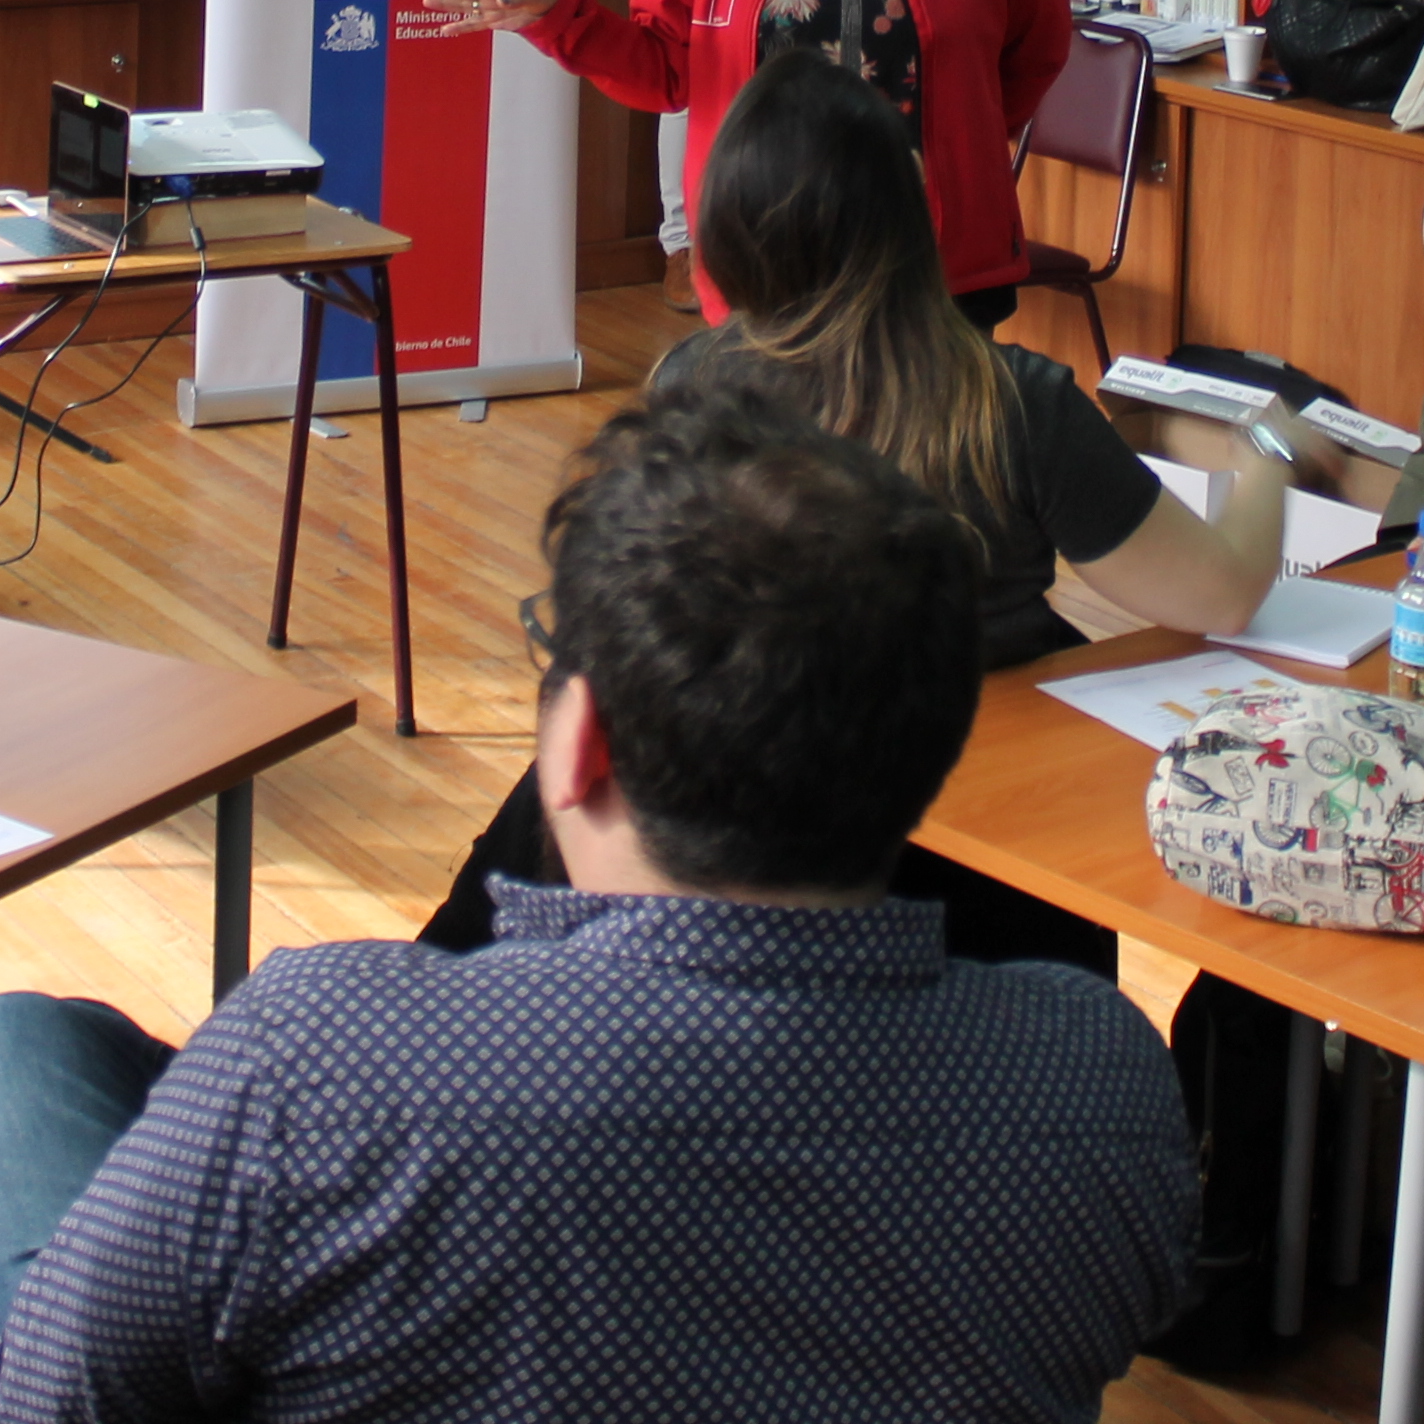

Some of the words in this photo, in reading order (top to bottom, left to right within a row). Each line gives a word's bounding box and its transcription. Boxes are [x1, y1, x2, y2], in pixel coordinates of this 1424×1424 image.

[395, 10, 461, 25] Ministerio
[394, 25, 459, 41] Educaci
[395, 341, 428, 352] bierno
[430, 338, 444, 349] de
[445, 335, 472, 348] Chile
[1118, 364, 1166, 384] equalit
[1320, 407, 1370, 433] equalit
